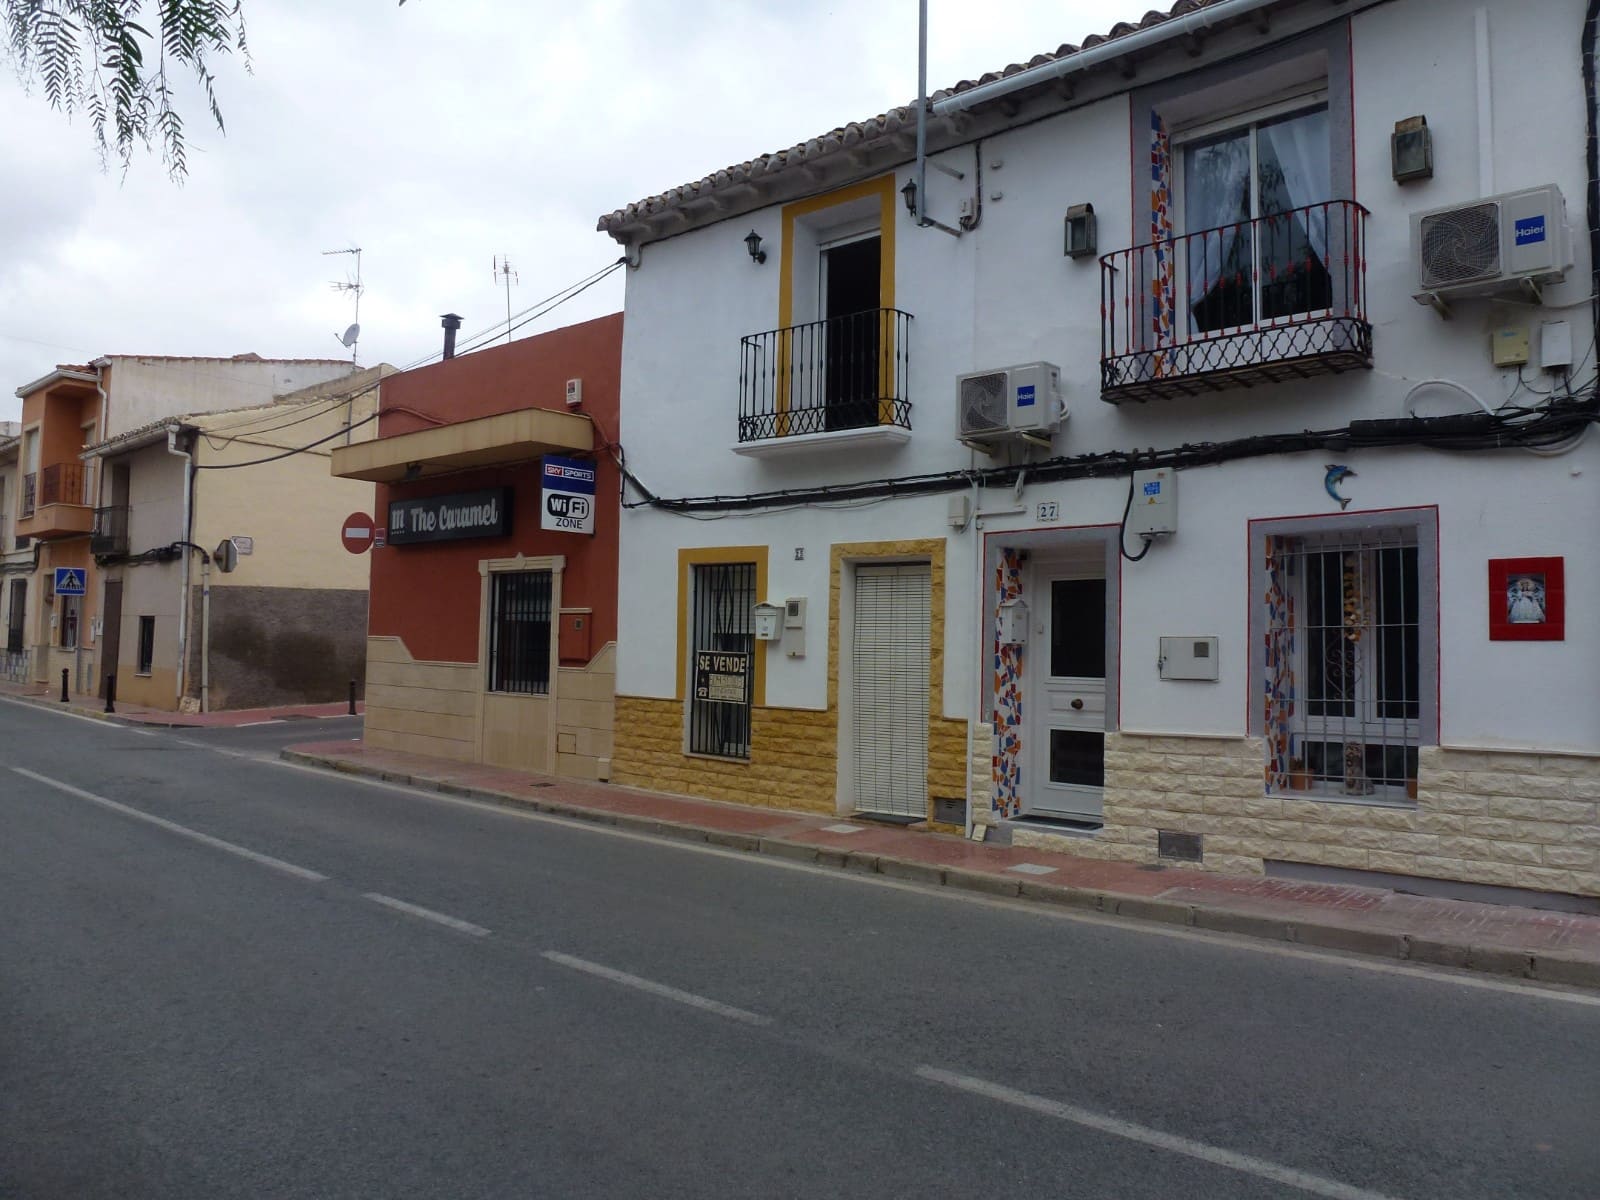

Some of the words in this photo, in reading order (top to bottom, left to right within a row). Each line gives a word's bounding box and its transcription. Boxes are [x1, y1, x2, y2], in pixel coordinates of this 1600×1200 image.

[1516, 226, 1544, 237] Haier
[547, 466, 561, 475] SKY
[564, 469, 592, 479] SPORTS
[410, 507, 437, 532] The
[438, 498, 498, 530] Caramel
[1040, 505, 1056, 518] 27
[555, 517, 584, 529] ZONE
[699, 655, 711, 671] SE
[713, 655, 746, 673] VENDE
